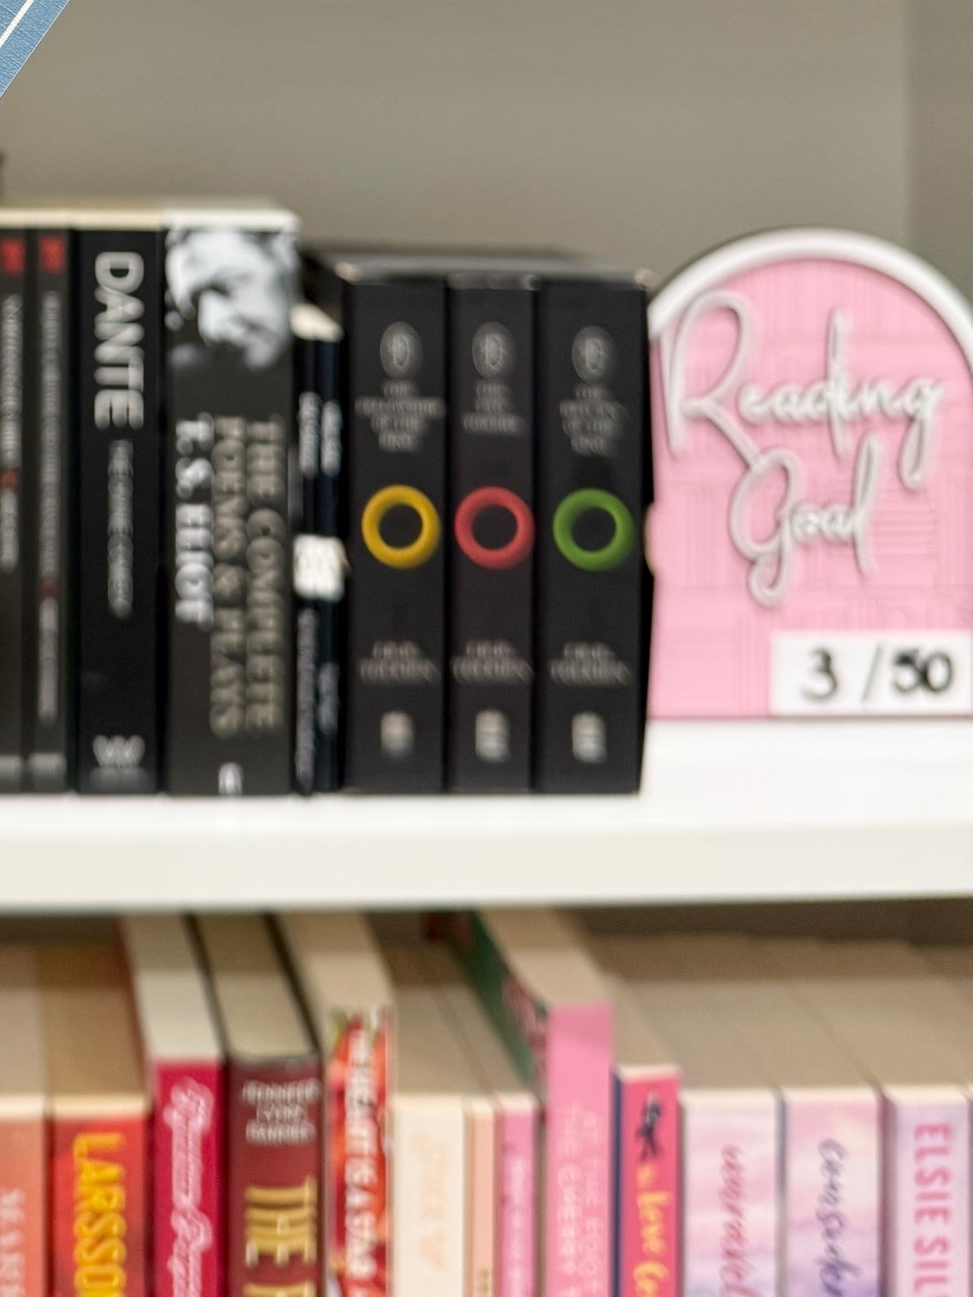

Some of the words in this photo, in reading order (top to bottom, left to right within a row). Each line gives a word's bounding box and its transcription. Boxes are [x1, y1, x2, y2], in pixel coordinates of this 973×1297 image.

[93, 250, 146, 431] DANTE
[658, 288, 945, 492] Reading
[211, 413, 248, 559] POEMS
[245, 414, 287, 500] THE
[728, 432, 879, 606] Goal
[174, 502, 214, 631] ELIOT
[245, 508, 287, 735] COMPLETE
[209, 605, 246, 739] PLAYS
[344, 1067, 379, 1156] HEART
[913, 1122, 953, 1225] ELSIE
[242, 1176, 318, 1268] THE
[343, 1210, 379, 1281] STAR
